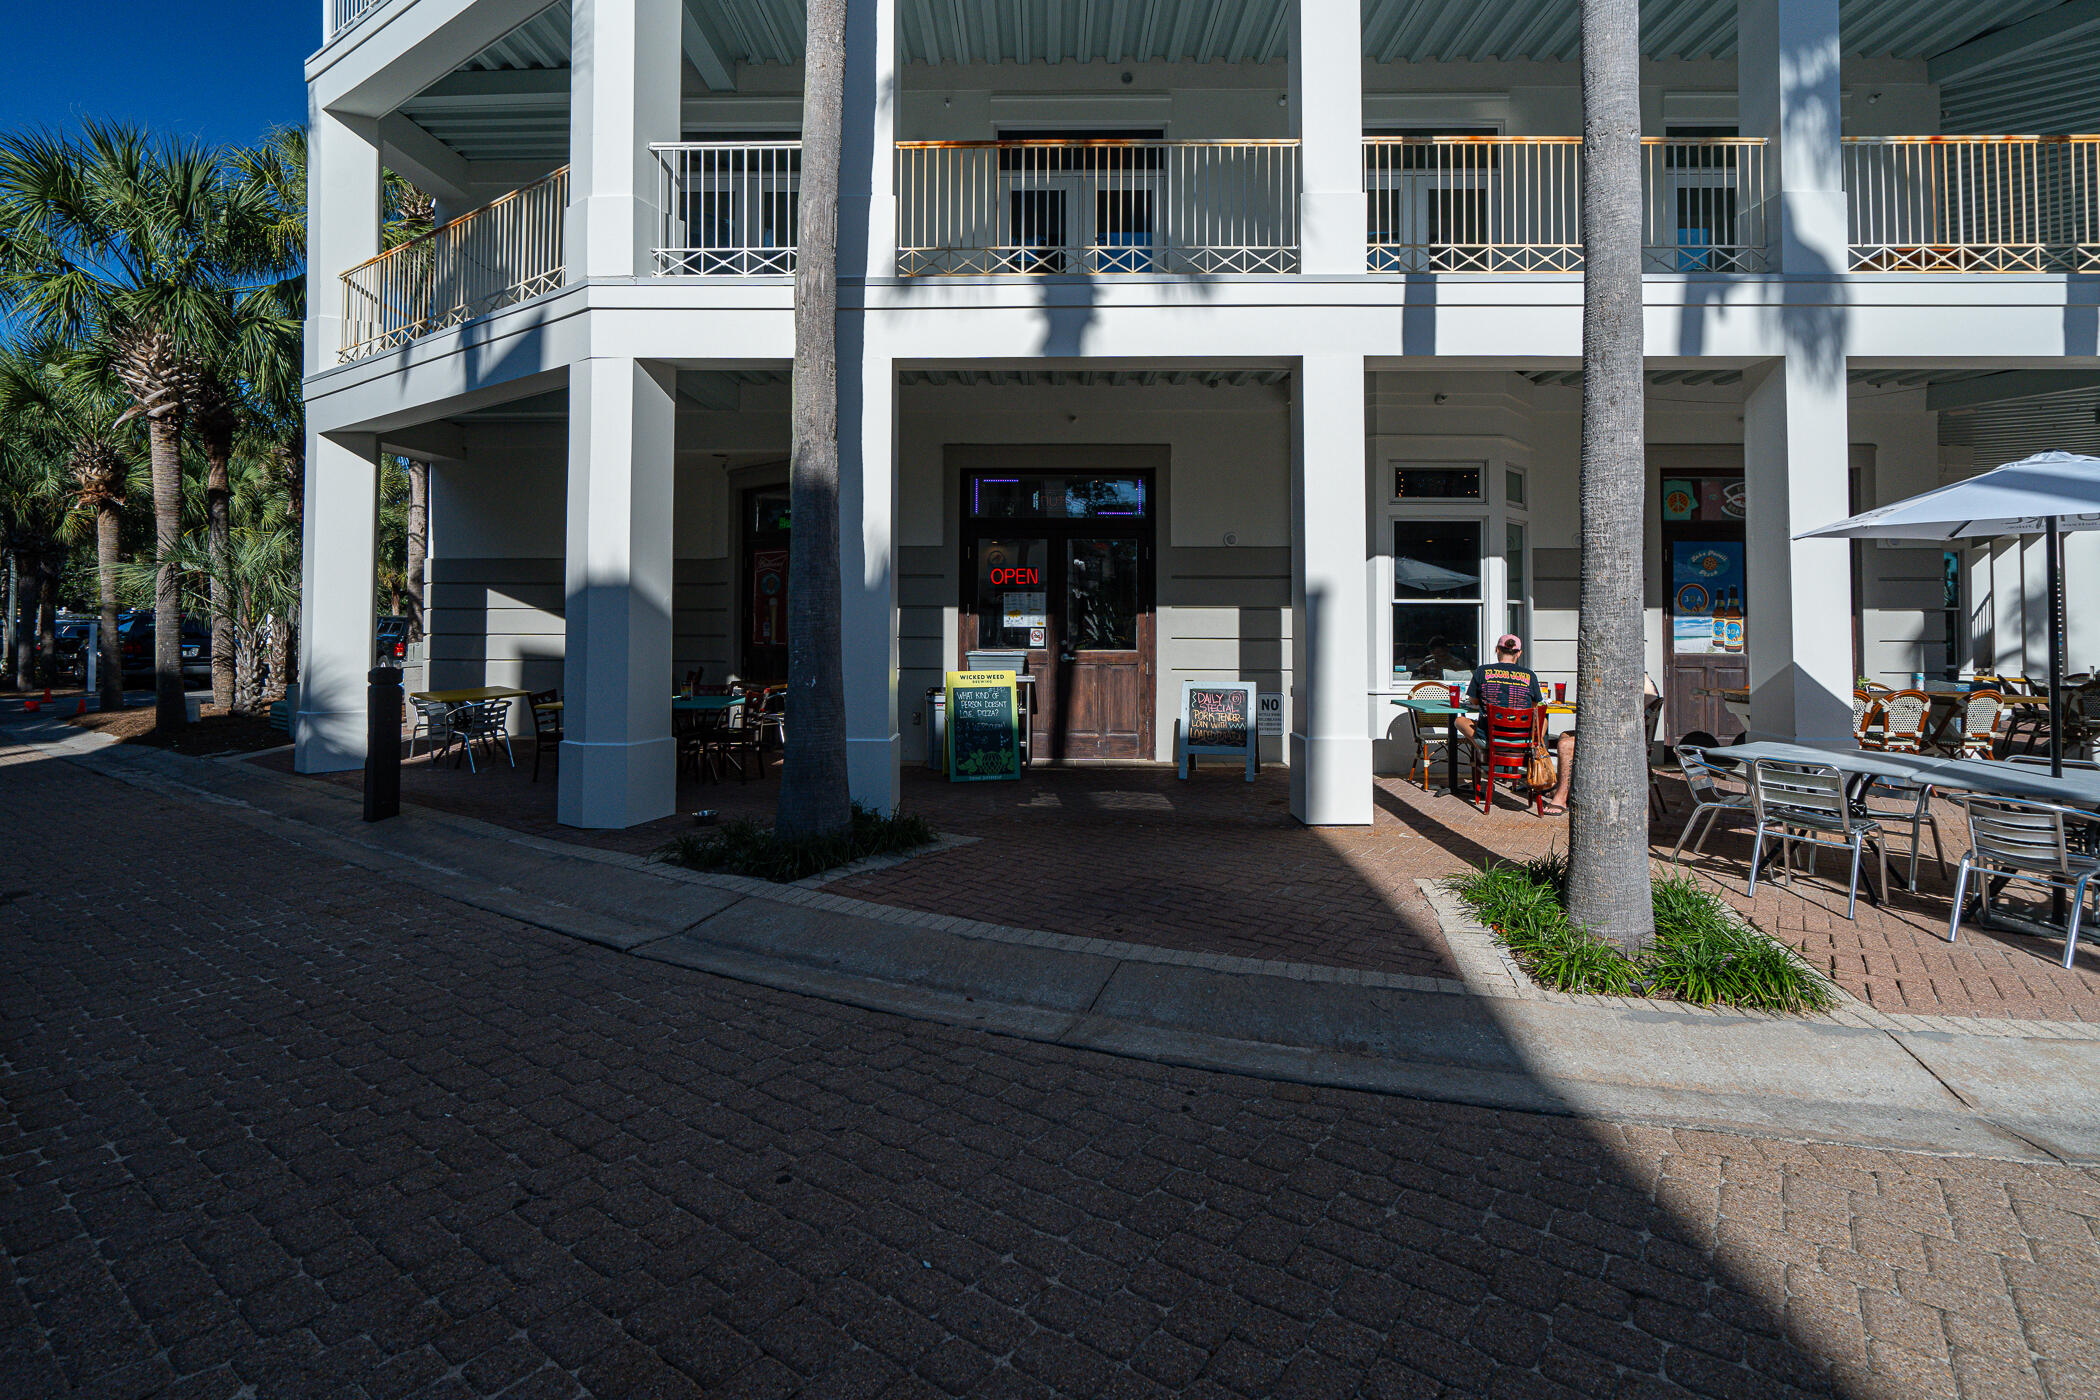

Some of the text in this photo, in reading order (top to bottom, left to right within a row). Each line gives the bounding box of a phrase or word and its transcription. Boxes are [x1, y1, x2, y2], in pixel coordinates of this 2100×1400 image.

[990, 568, 1038, 584] OPEN
[1484, 669, 1509, 680] ELTON
[1510, 671, 1531, 686] JOHN
[957, 692, 999, 700] WHAT KIND OF
[1197, 692, 1224, 705] DAILY
[961, 700, 982, 708] PERSON
[1200, 703, 1239, 712] SPECIAL
[1261, 699, 1279, 710] NO
[977, 709, 999, 717] PIZZA?
[1193, 710, 1215, 721] PORK
[1191, 720, 1208, 728] LOIN
